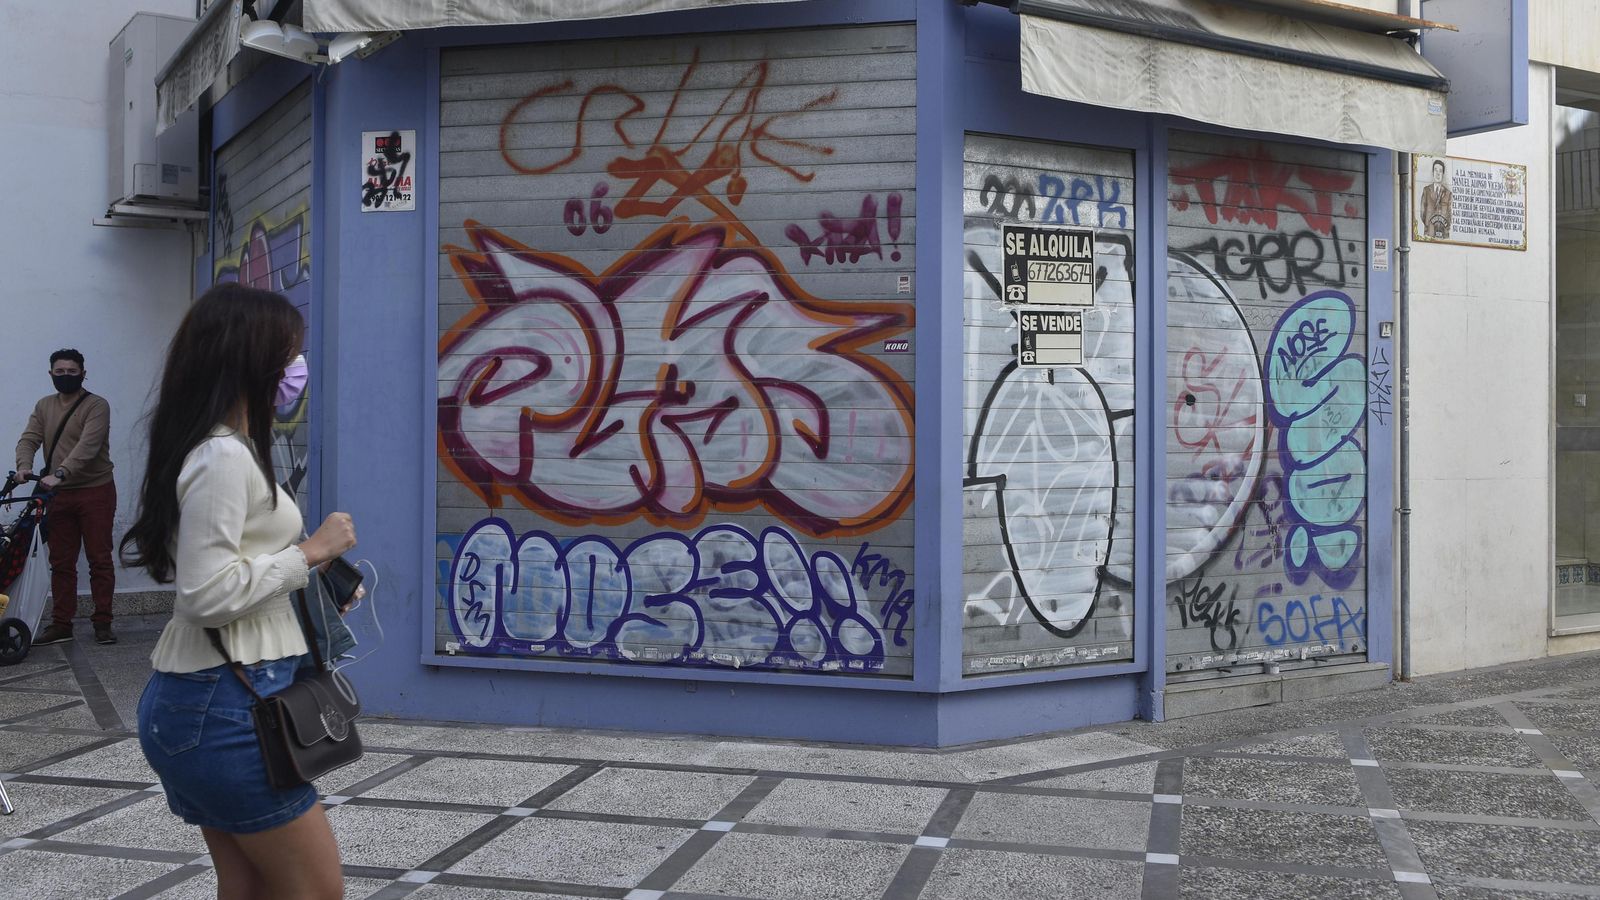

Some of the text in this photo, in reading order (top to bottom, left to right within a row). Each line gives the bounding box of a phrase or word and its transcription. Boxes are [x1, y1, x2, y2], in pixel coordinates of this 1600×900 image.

[1006, 232, 1092, 258] SE ALQUILA
[1028, 262, 1092, 283] 677263674
[1022, 314, 1080, 332] SE VENDE
[885, 342, 908, 351] KOKO
